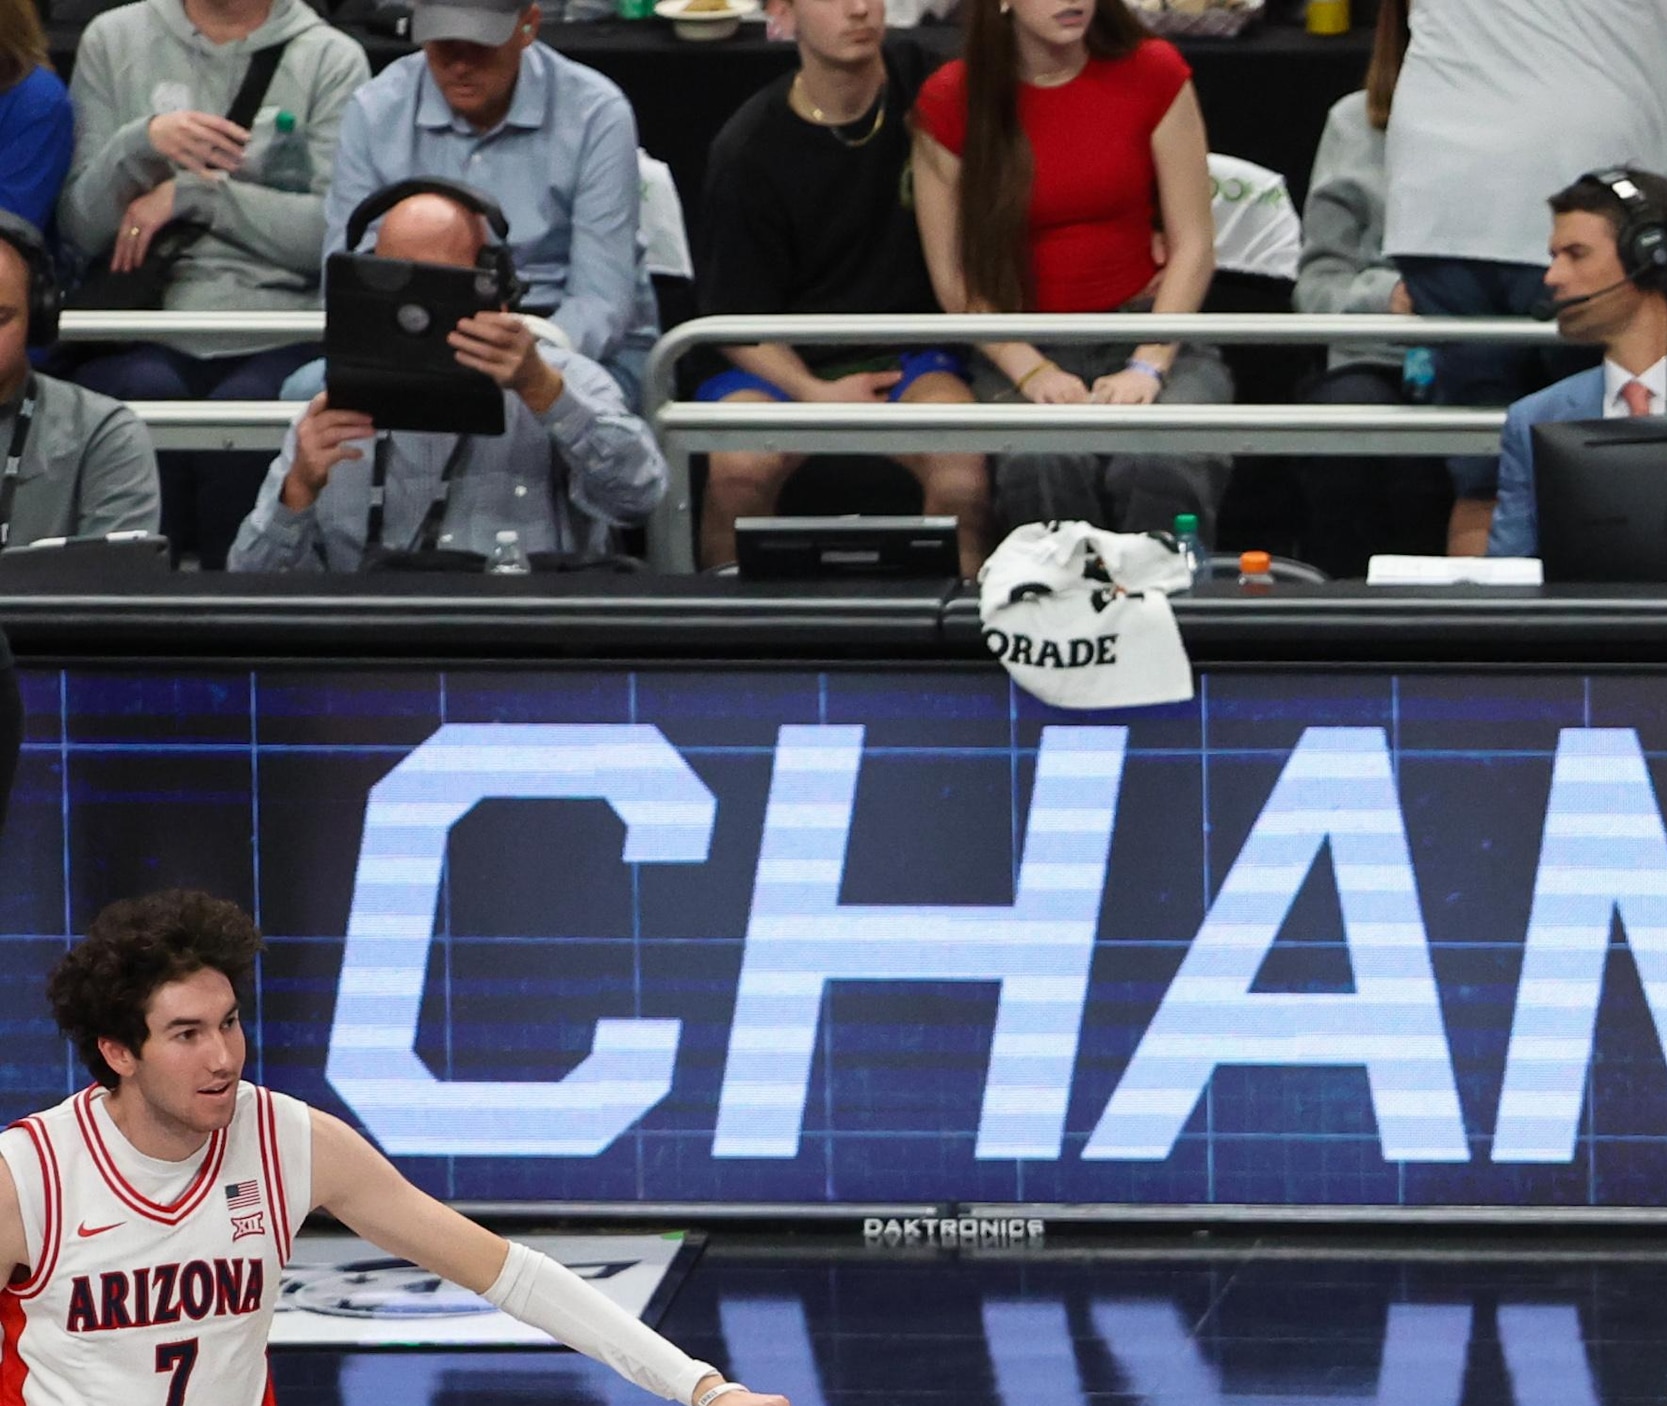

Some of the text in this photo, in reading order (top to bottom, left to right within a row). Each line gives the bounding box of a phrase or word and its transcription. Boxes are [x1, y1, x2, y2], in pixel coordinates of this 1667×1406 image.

[232, 1213, 264, 1241] XII
[864, 1218, 1044, 1237] DAKTRONICS
[66, 1258, 263, 1333] ARIZONA
